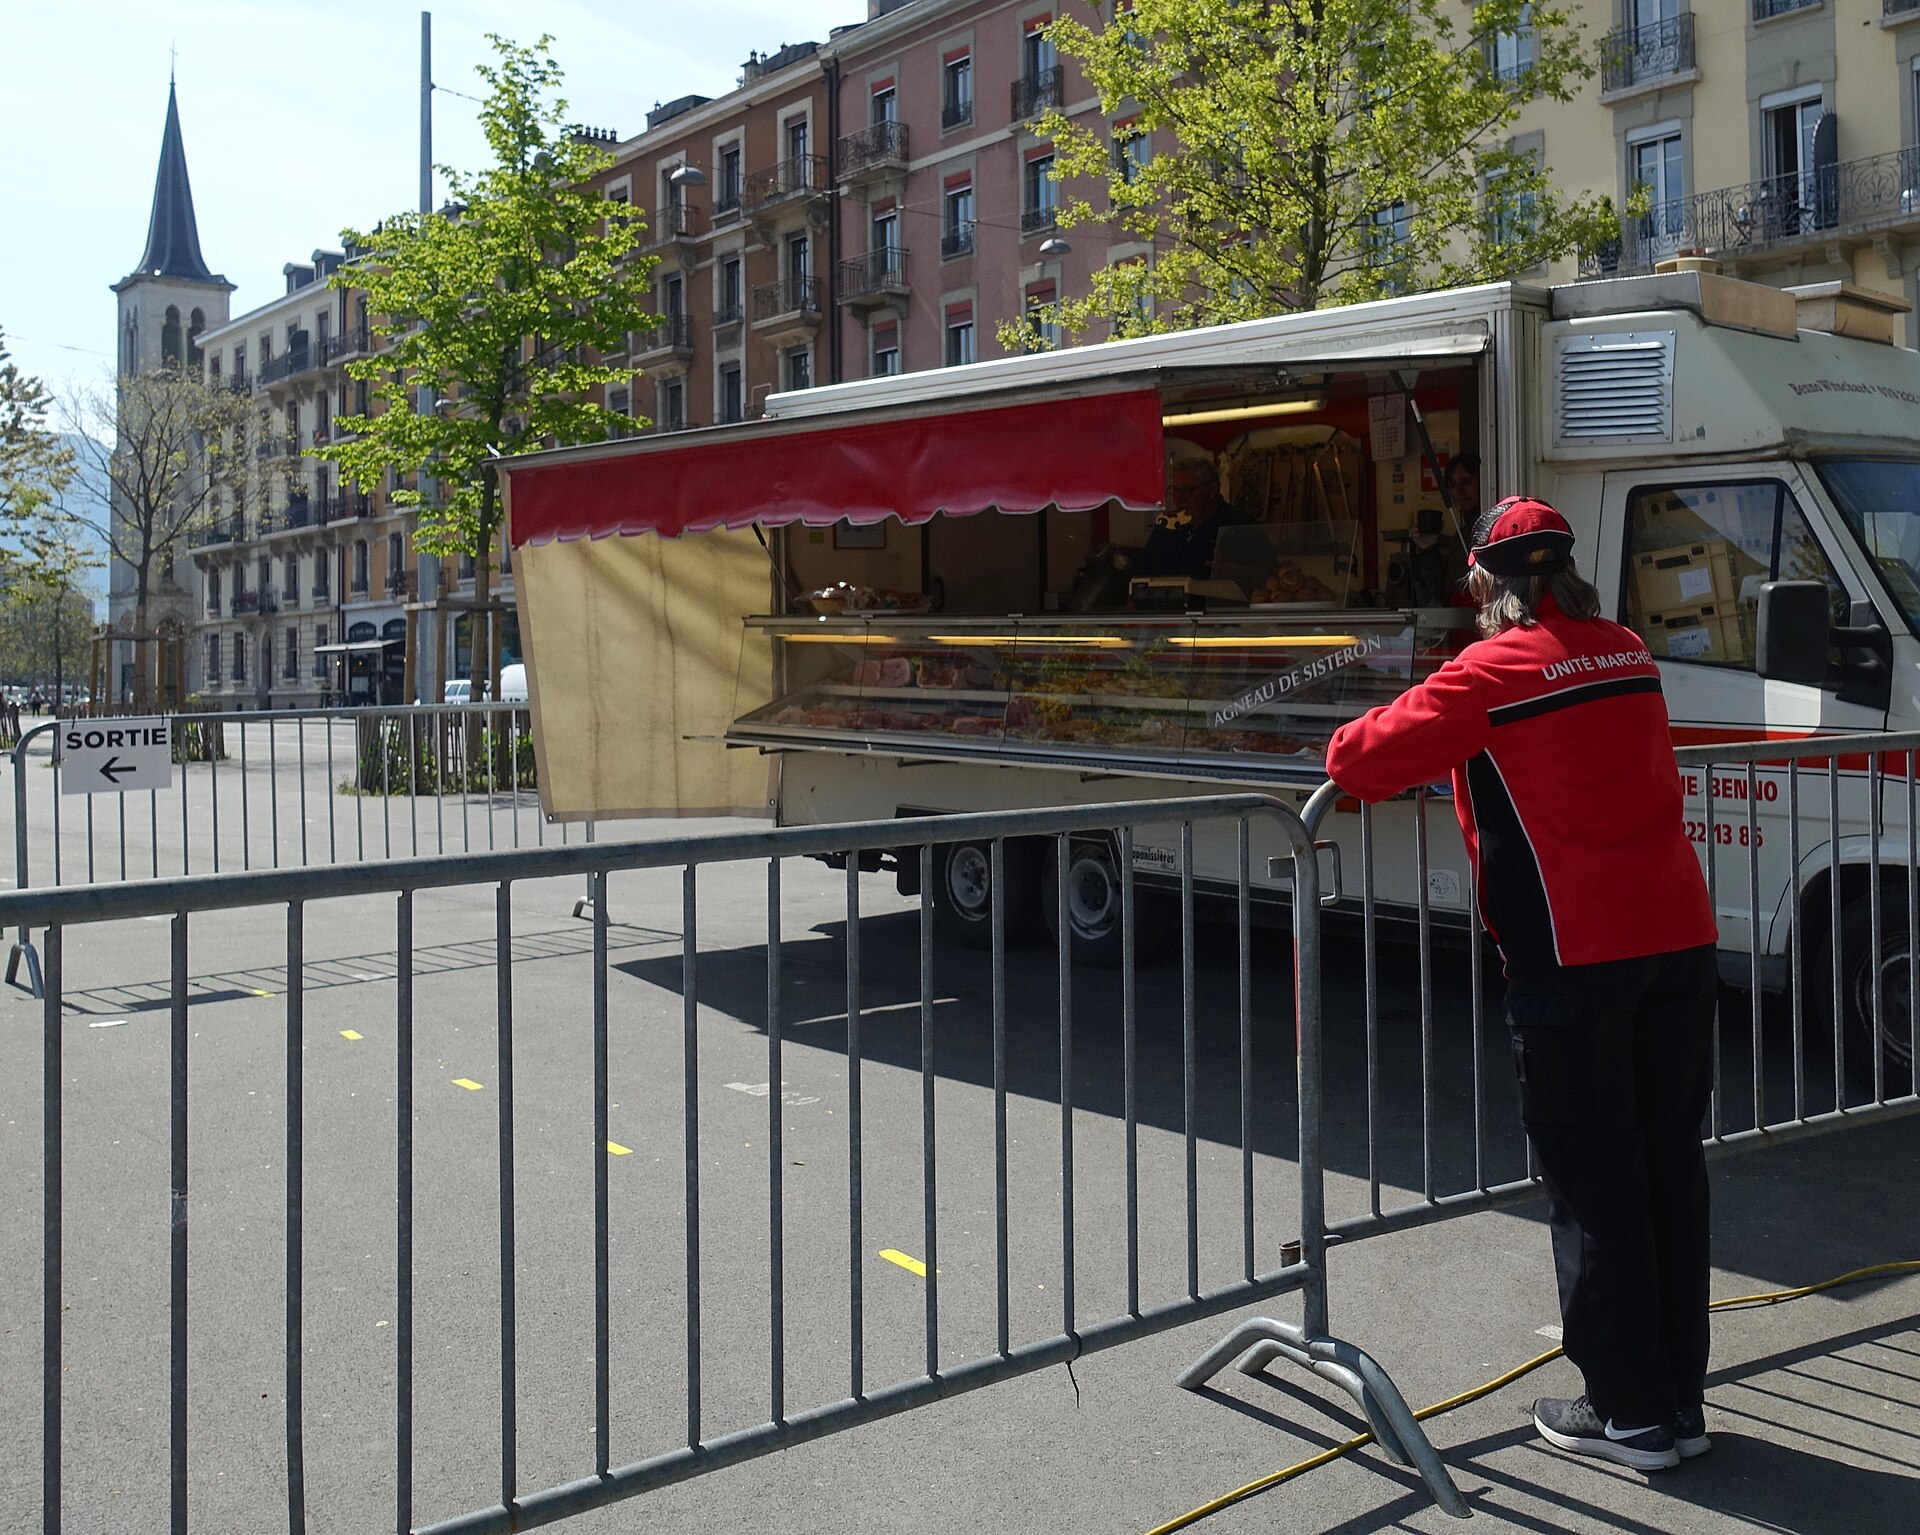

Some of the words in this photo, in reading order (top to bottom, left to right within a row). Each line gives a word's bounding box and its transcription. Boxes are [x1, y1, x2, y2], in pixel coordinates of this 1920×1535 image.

[1542, 654, 1595, 681] UNITÉ
[1214, 682, 1275, 727] AGNEAU
[1278, 670, 1300, 693] DE
[1303, 634, 1382, 682] SISTERON
[66, 728, 167, 749] SORTIE
[1713, 823, 1732, 844] 13
